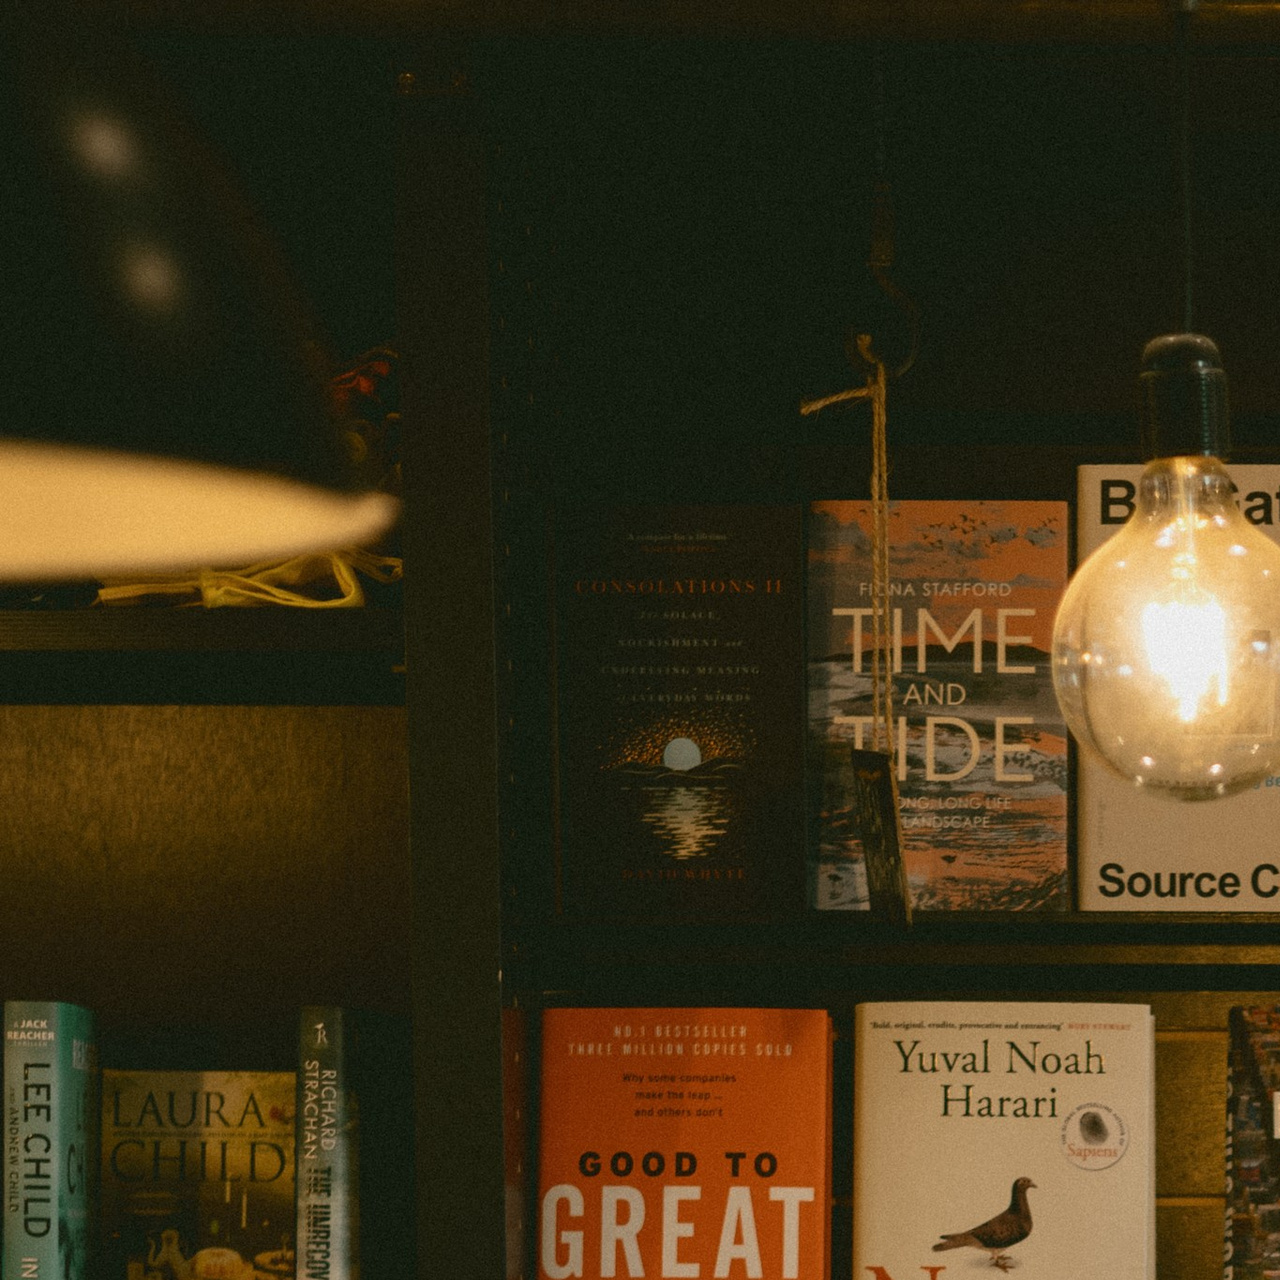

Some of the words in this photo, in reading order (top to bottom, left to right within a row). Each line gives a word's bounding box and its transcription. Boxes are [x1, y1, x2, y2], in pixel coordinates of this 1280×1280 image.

[922, 582, 1011, 596] STAFFORD
[832, 608, 1036, 673] TIME
[903, 684, 966, 705] AND
[833, 717, 1034, 782] TIDE
[1099, 863, 1240, 898] Source
[894, 1040, 990, 1074] Yuval
[1006, 1040, 1106, 1074] Noah
[24, 1062, 51, 1124] LEE
[111, 1090, 266, 1128] LAURA
[941, 1085, 1058, 1118] Harari
[579, 1152, 697, 1177] GOOD
[726, 1152, 779, 1177] TO
[23, 1130, 51, 1237] CHILD
[541, 1184, 815, 1280] GREAT
[22, 1258, 38, 1276] IN
